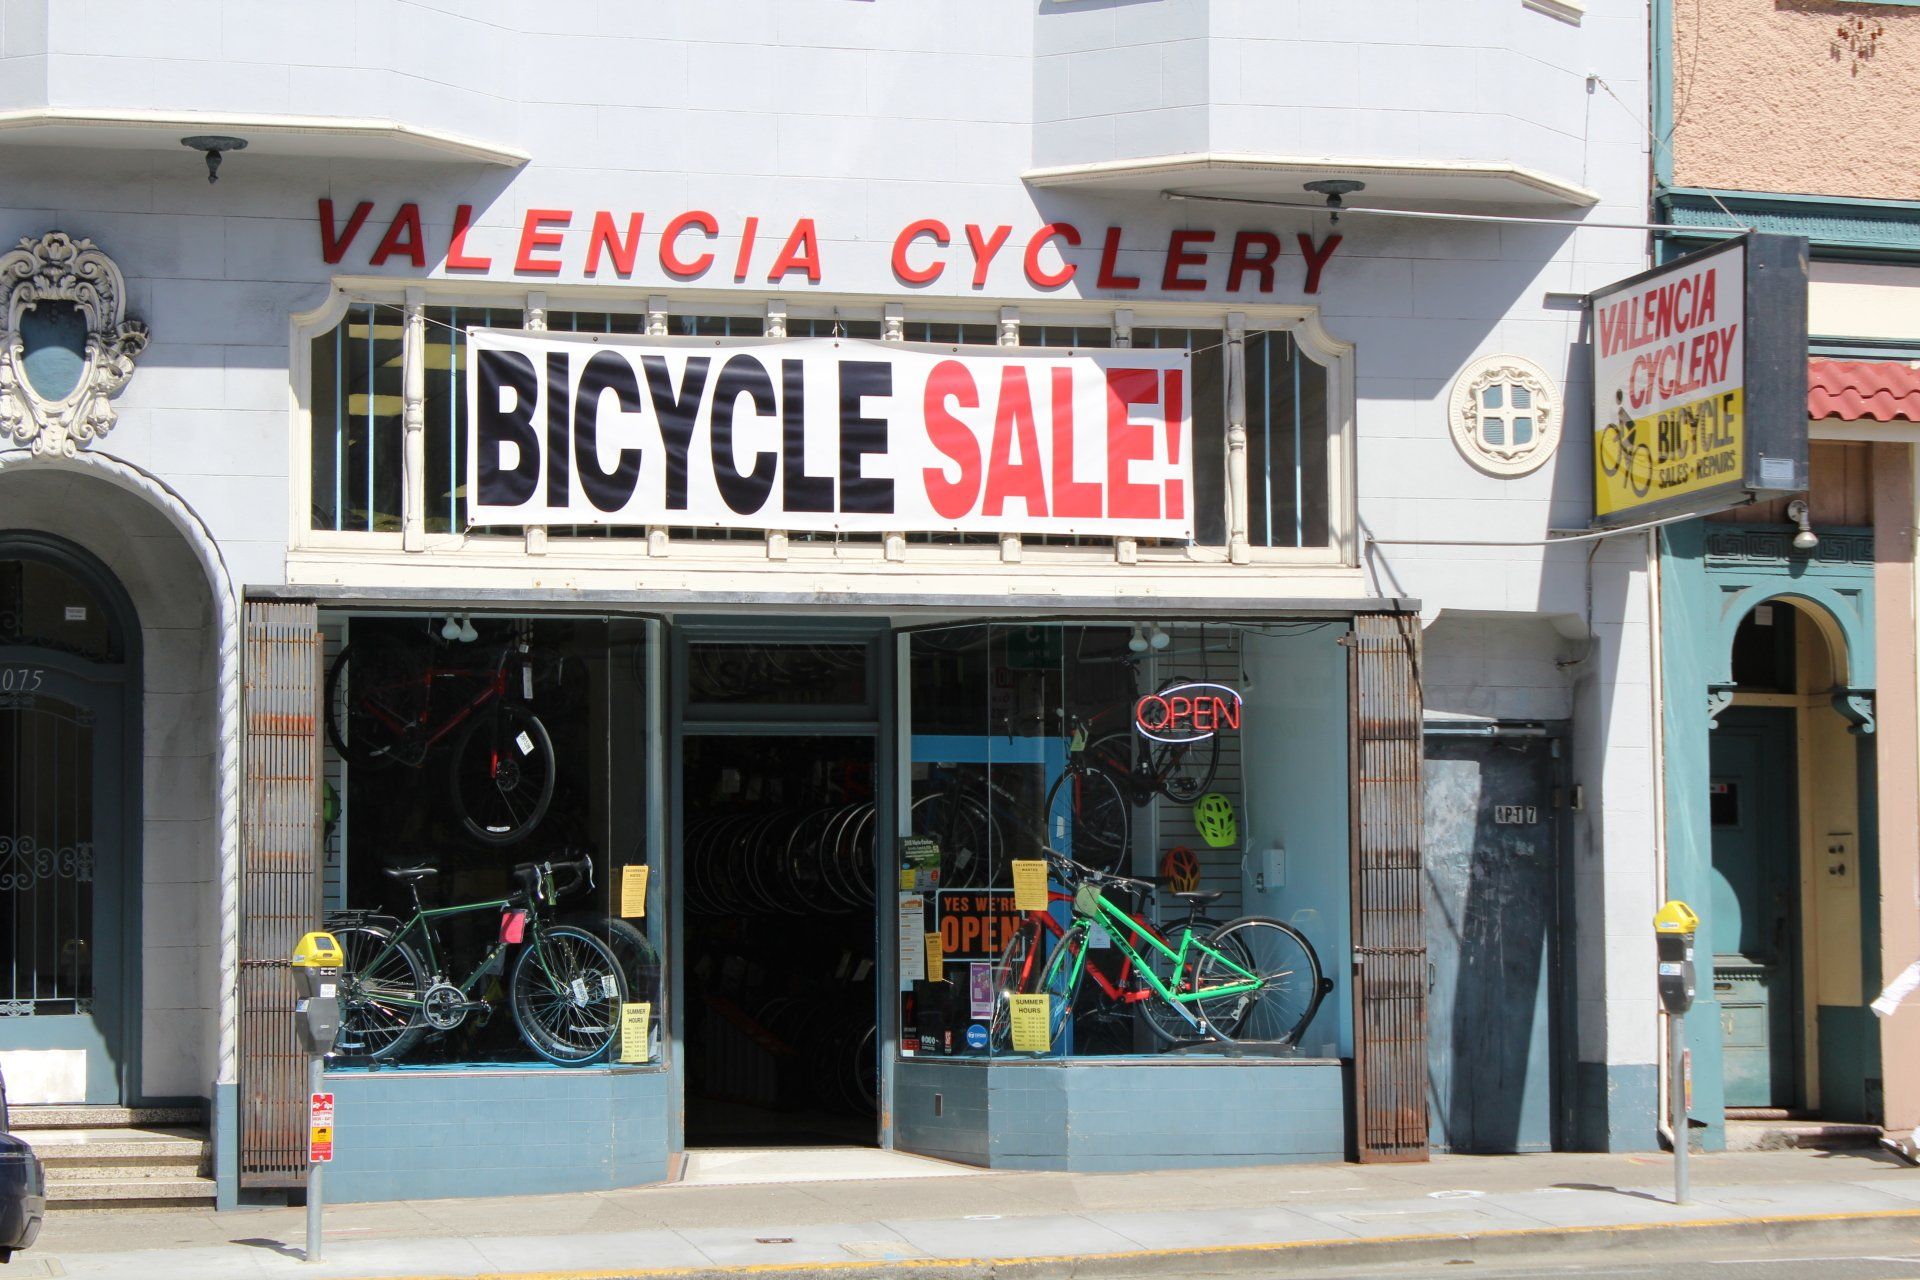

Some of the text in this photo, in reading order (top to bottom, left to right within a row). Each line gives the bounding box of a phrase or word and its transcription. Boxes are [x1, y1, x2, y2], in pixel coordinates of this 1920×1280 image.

[318, 198, 1343, 294] VALENCIA CYCLERY
[1599, 268, 1716, 358] VALENCIA
[1629, 324, 1737, 409] CYCLERY
[477, 348, 1185, 520] BICYCLE SALE!
[1658, 393, 1734, 463] BICYCLE
[1658, 462, 1689, 489] SALES
[1696, 450, 1736, 480] REPAIRS
[1136, 694, 1240, 729] OPEN
[1527, 806, 1536, 823] 7
[944, 897, 1017, 912] YES WE'RE
[941, 915, 1020, 953] OPEN
